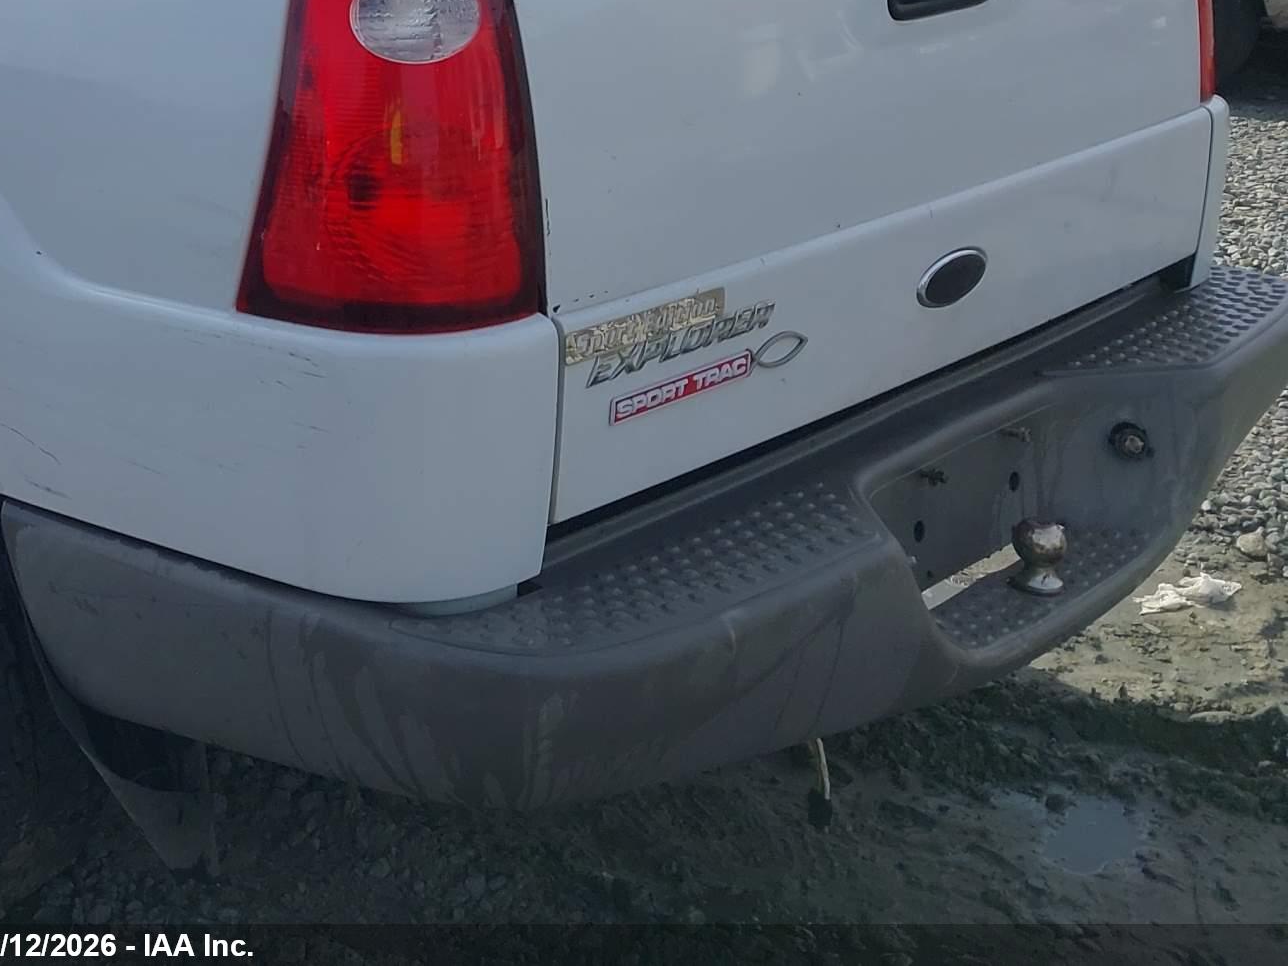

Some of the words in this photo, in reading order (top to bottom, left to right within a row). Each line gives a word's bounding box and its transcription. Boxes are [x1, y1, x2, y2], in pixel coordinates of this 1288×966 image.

[586, 300, 776, 388] EXPLORER
[616, 378, 689, 417] SPORT
[693, 357, 746, 391] TRAC
